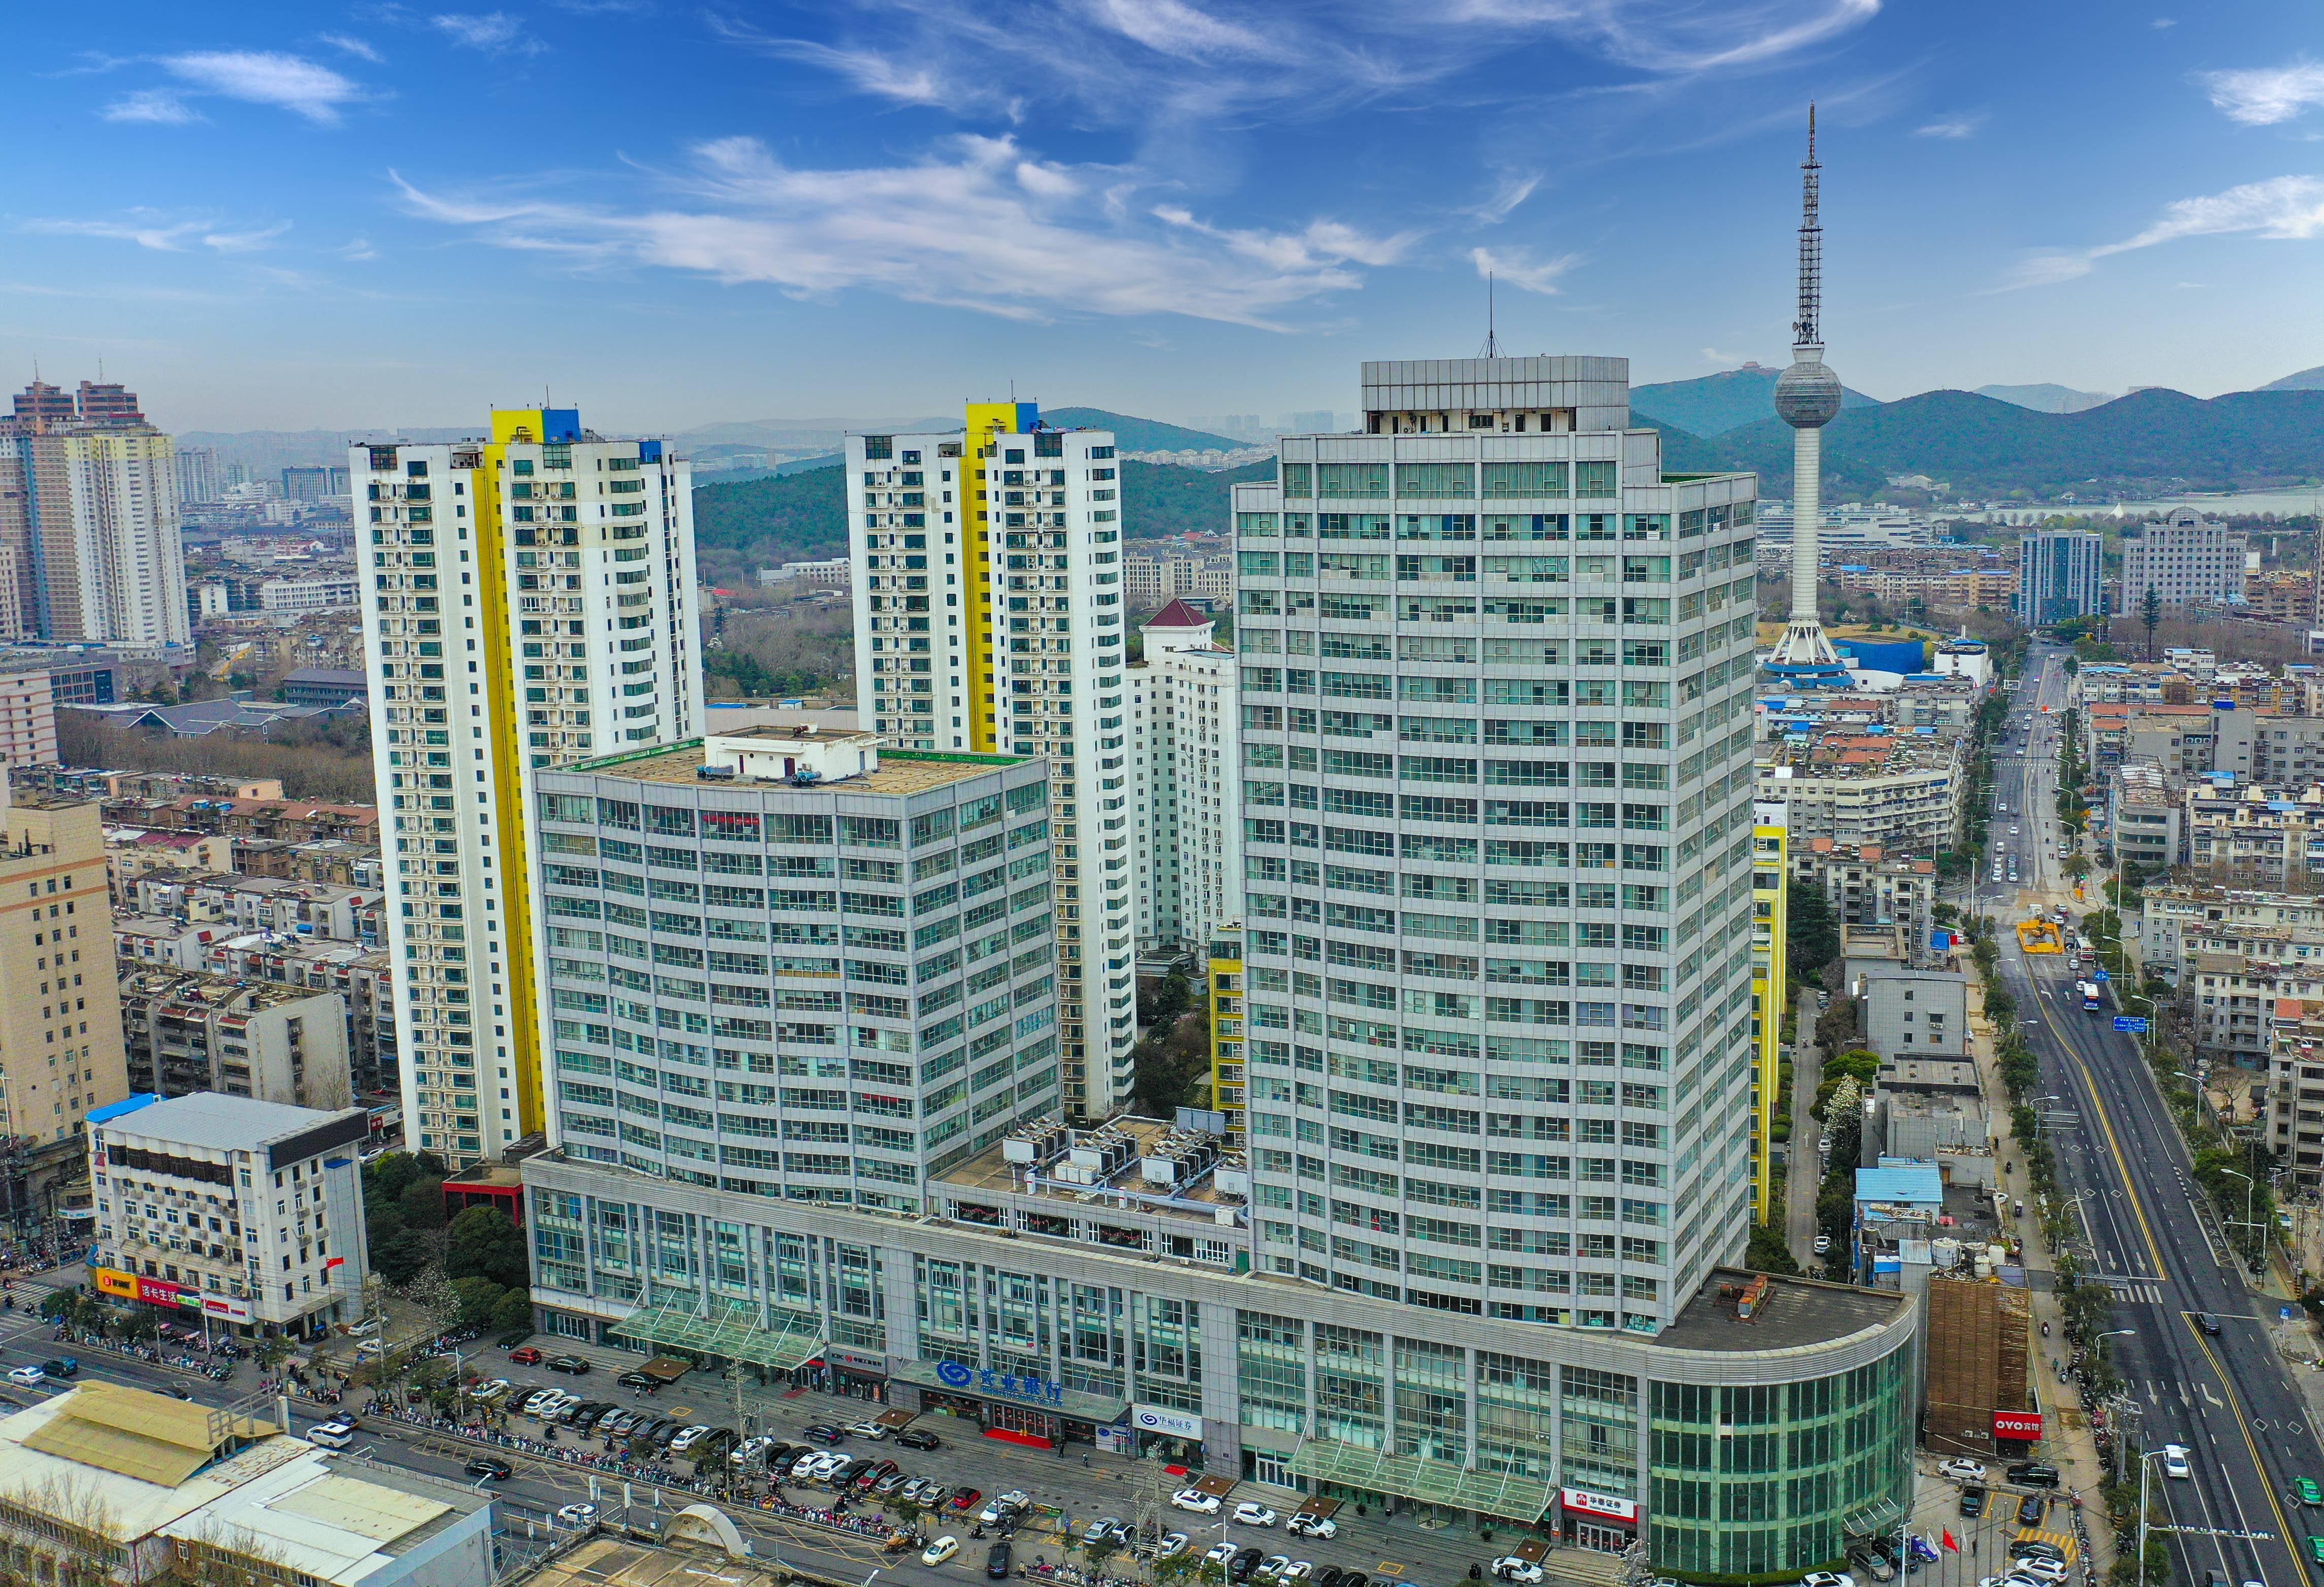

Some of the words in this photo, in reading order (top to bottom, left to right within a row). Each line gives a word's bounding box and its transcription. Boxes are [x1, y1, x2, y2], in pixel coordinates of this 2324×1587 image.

[142, 1285, 176, 1303] 洛卡生活
[1159, 1415, 1192, 1430] 华福证券
[1589, 1496, 1621, 1509] 华泰证券
